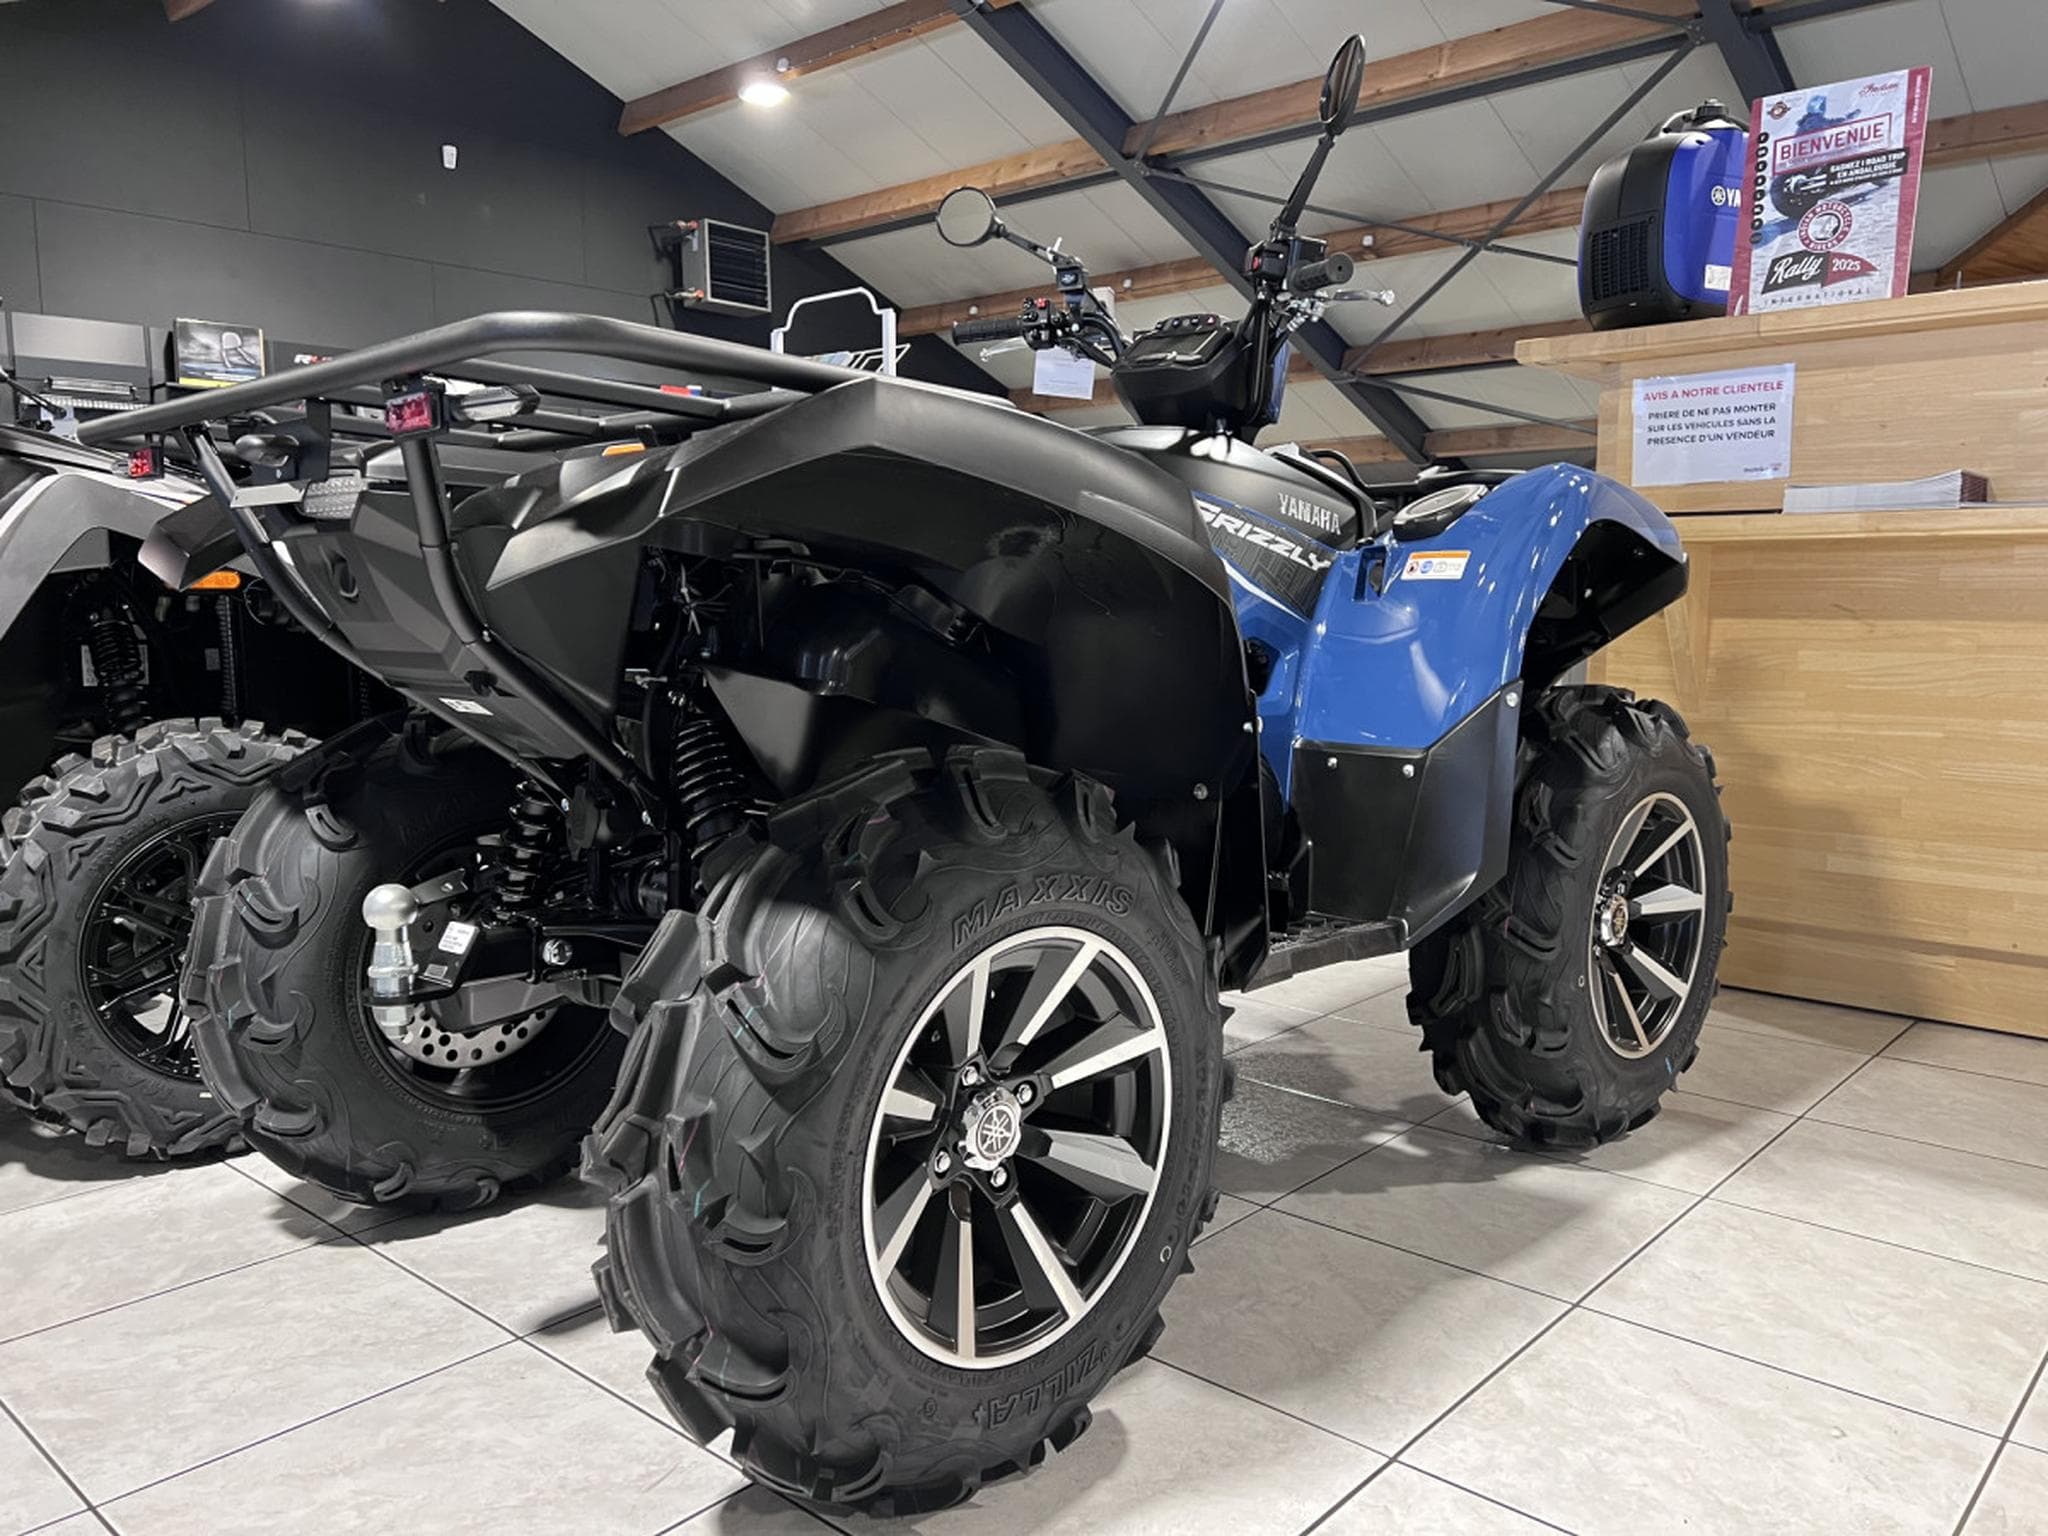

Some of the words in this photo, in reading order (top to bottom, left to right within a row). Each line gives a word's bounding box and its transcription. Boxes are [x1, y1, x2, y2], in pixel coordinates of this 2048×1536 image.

[1780, 121, 1885, 161] BIENVENUE
[1768, 255, 1824, 285] Rally
[1832, 258, 1861, 272] 2025
[1643, 390, 1668, 401] AVIS
[1670, 389, 1679, 399] A
[1681, 386, 1720, 399] NOTRE
[1722, 380, 1784, 395] CLIENTELE
[1648, 410, 1680, 420] PRIERE
[1682, 409, 1695, 418] DE
[1697, 407, 1710, 416] NE
[1712, 405, 1731, 415] PAS
[1733, 402, 1777, 414] MONTER
[1647, 424, 1665, 433] SUR
[1667, 422, 1683, 432] LES
[1684, 419, 1734, 430] VEHICULES
[1736, 417, 1762, 428] SANS
[1763, 416, 1776, 425] LA
[1647, 434, 1697, 446] PRESENCE
[1699, 432, 1724, 443] D'UN
[1726, 429, 1776, 441] VENDEUR
[1278, 492, 1341, 535] YAMAHA
[952, 875, 1134, 949] MAXXIS
